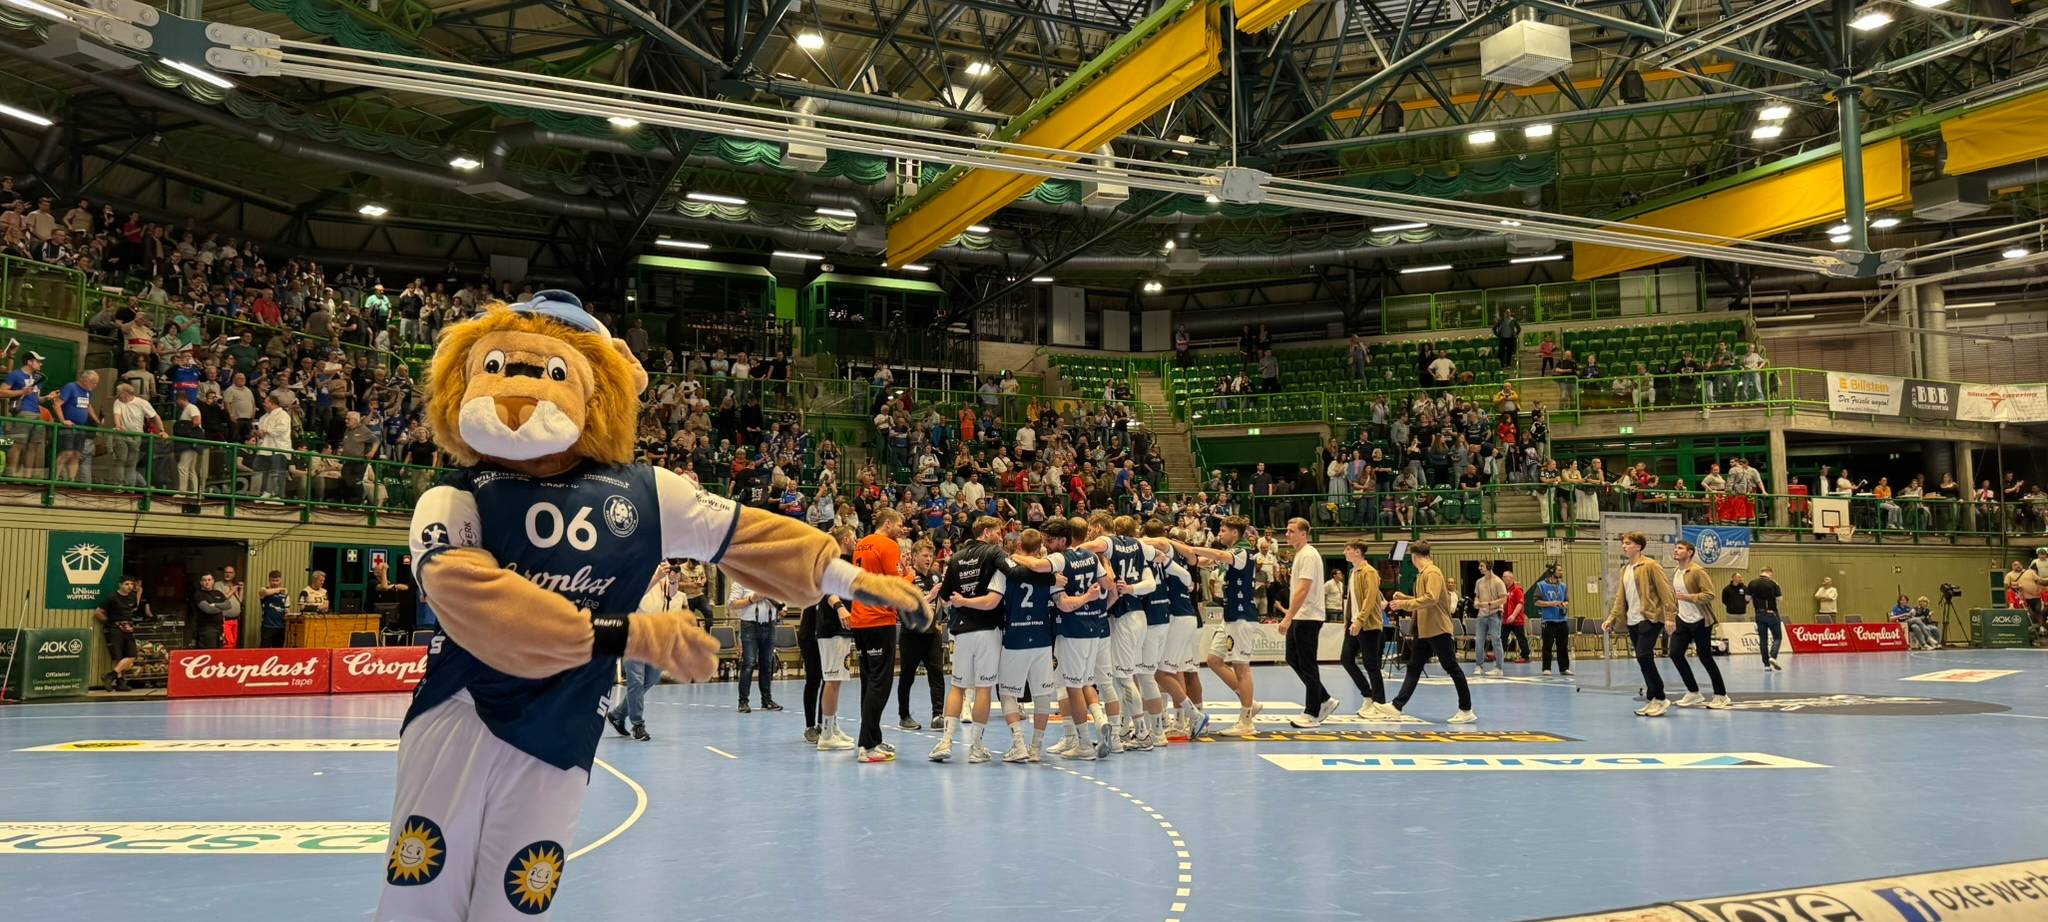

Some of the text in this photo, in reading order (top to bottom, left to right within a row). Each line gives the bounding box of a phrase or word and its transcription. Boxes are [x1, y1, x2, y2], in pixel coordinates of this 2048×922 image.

[1851, 379, 1889, 393] Billstein
[525, 501, 598, 551] 06
[1119, 558, 1140, 582] 14
[1020, 582, 1034, 608] 2
[1992, 616, 2012, 624] AOK
[1792, 626, 1847, 643] Coroplast
[1853, 626, 1901, 643] Coroplast
[39, 641, 68, 654] AOK
[180, 654, 319, 683] Coroplast
[342, 652, 427, 680] Coropl
[291, 678, 313, 686] tape
[1322, 758, 1665, 767] DAIKIN
[145, 823, 389, 832] portstadt
